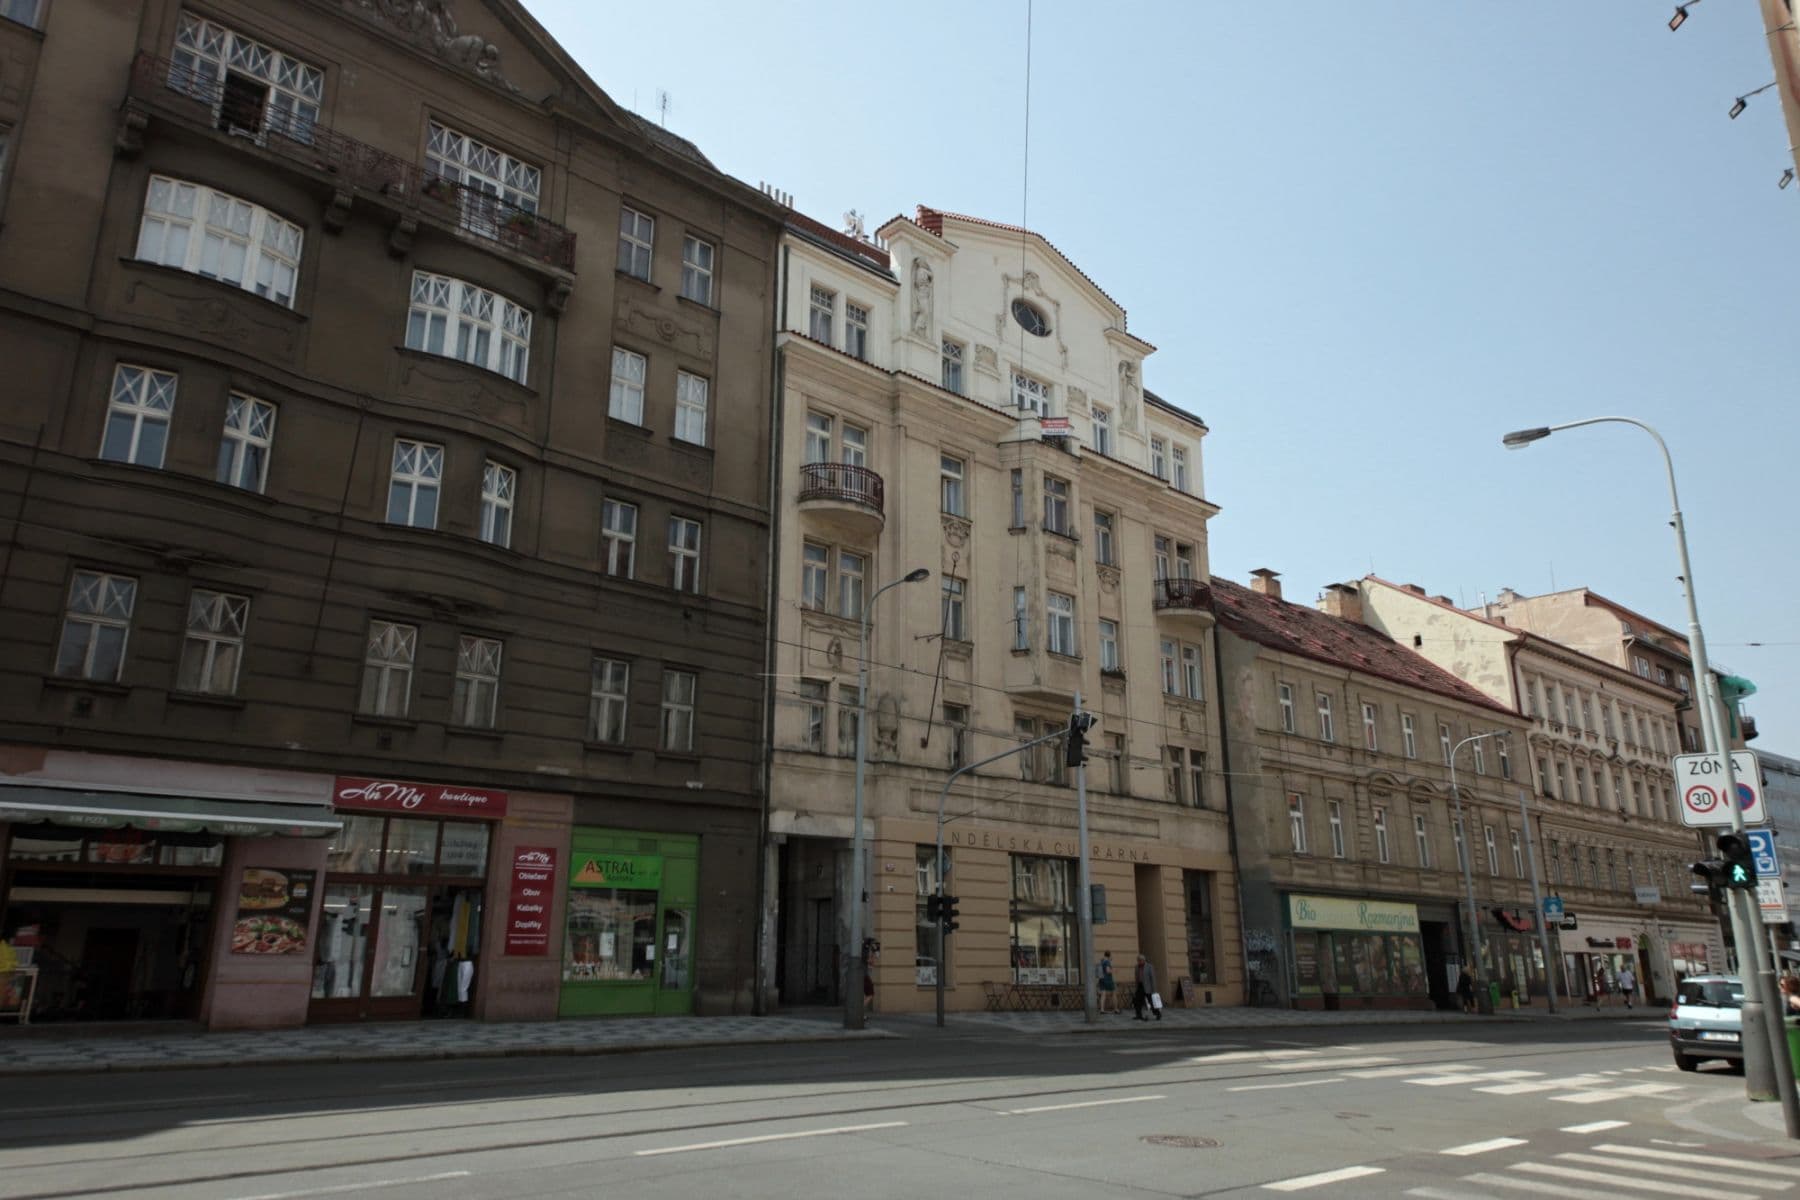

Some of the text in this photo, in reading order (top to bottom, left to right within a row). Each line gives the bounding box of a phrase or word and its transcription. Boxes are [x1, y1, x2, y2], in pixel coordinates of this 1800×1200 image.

[440, 790, 488, 806] boutique
[1692, 792, 1711, 806] 30
[586, 860, 635, 875] ASTRAL
[522, 888, 541, 896] Obuv
[1296, 899, 1316, 920] Bio
